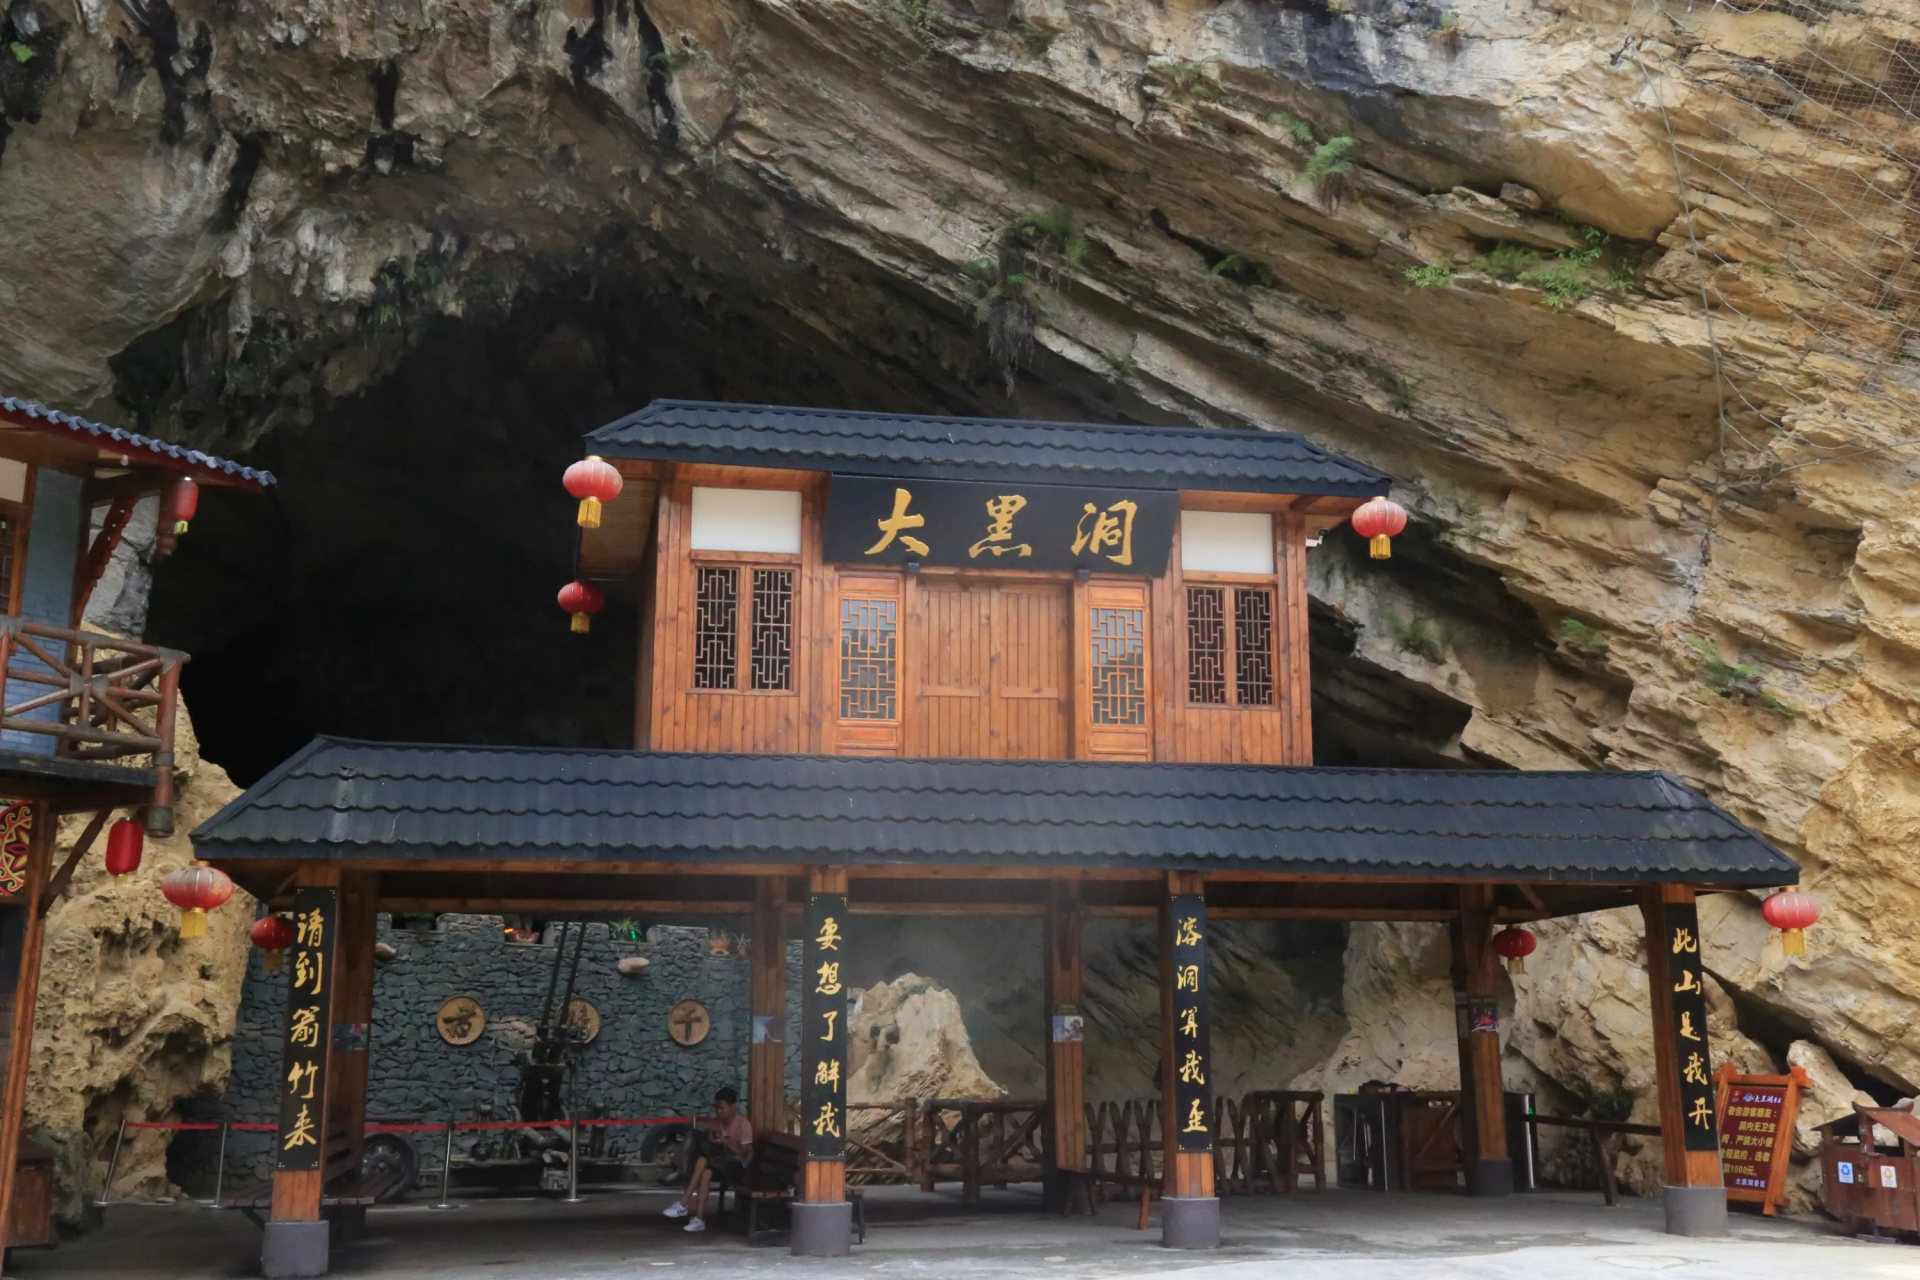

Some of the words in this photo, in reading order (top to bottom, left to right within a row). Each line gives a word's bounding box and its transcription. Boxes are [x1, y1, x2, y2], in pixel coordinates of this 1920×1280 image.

[864, 488, 1137, 565] 大黑洞
[813, 917, 842, 1138] 要想了解我
[1176, 917, 1208, 1133] 溶洞算我歪
[1673, 928, 1713, 1130] 此山是我开
[1728, 1106, 1777, 1118] 敬告游客朋友：
[1738, 1121, 1776, 1133] 洞内无卫生
